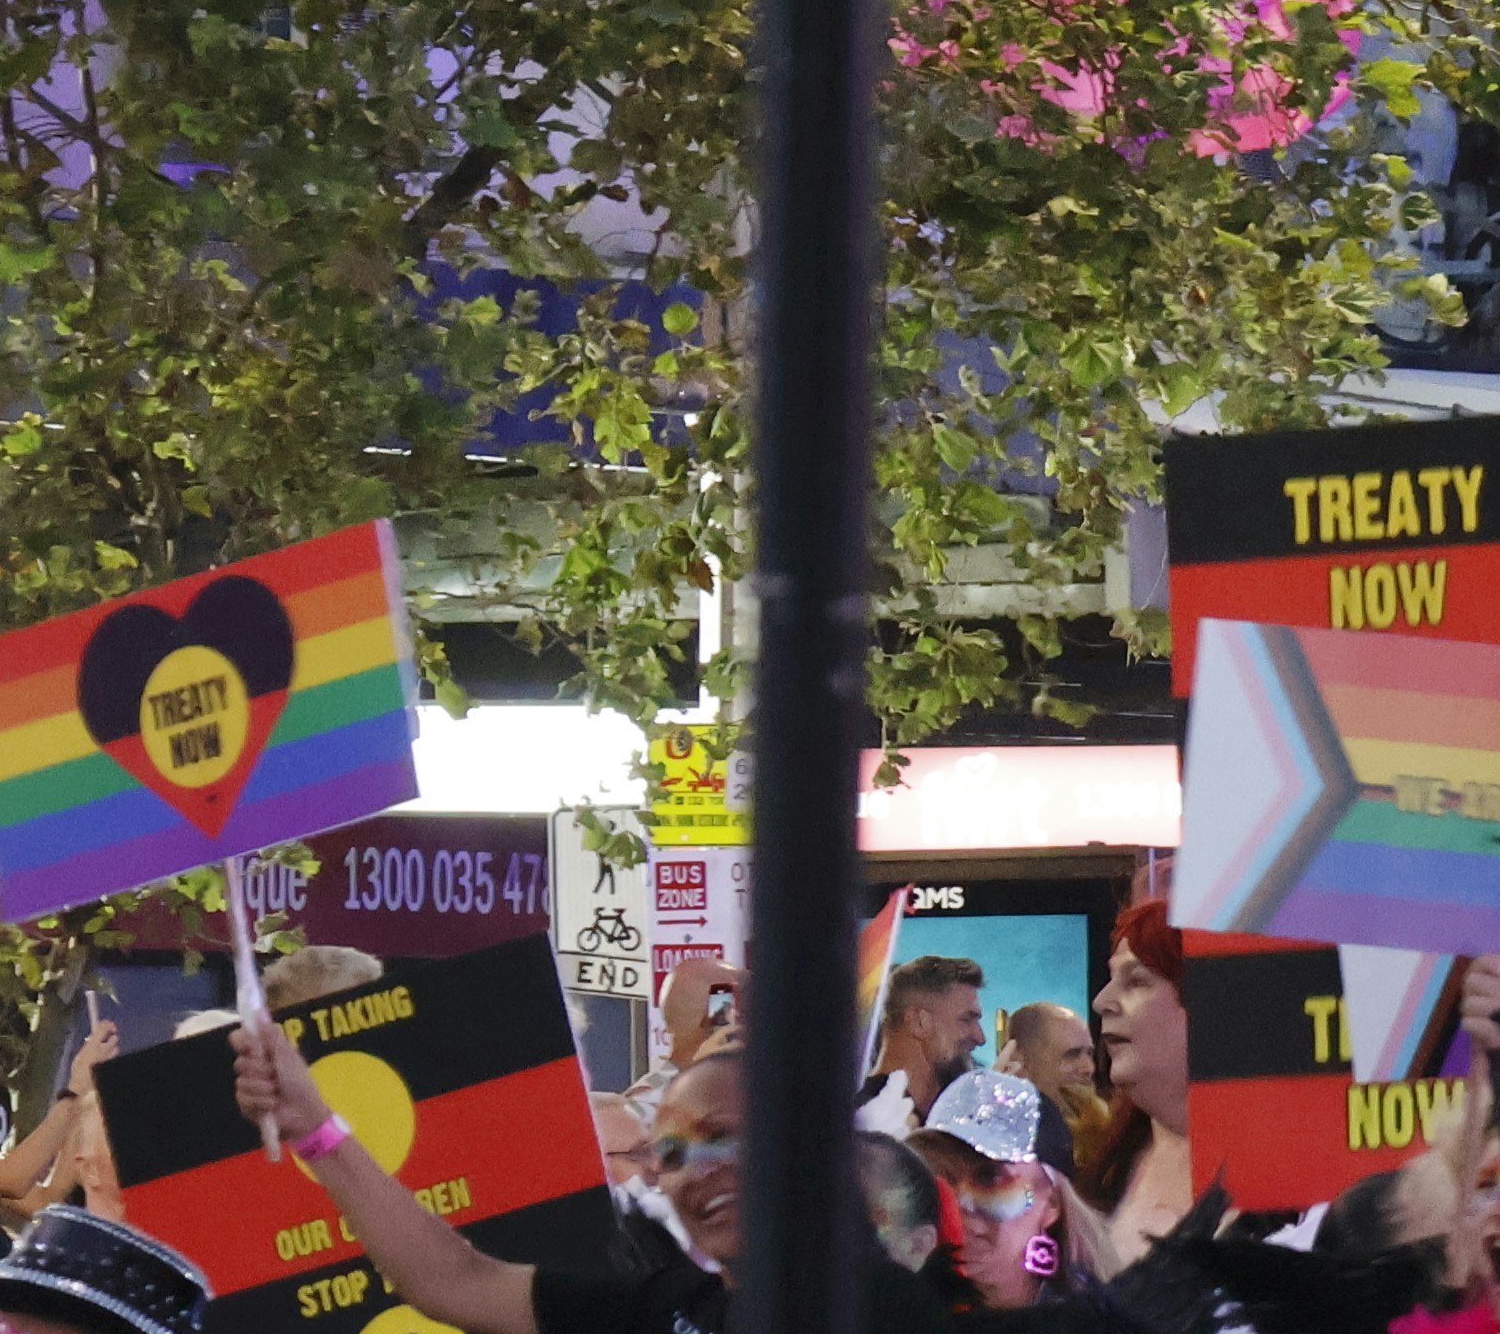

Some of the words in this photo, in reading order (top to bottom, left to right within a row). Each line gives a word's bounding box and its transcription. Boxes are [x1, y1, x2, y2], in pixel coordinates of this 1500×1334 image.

[1284, 465, 1483, 545] TREATY
[1329, 560, 1448, 629] NOW
[150, 674, 229, 729] TREATY
[171, 722, 222, 768] NOW
[345, 847, 424, 911] 1300
[432, 851, 495, 914] 035
[658, 888, 705, 908] ZONE
[660, 866, 702, 884] BUS
[577, 961, 638, 988] END
[310, 985, 415, 1042] TAKING
[276, 1219, 333, 1260] OUR
[297, 1270, 369, 1317] STOP
